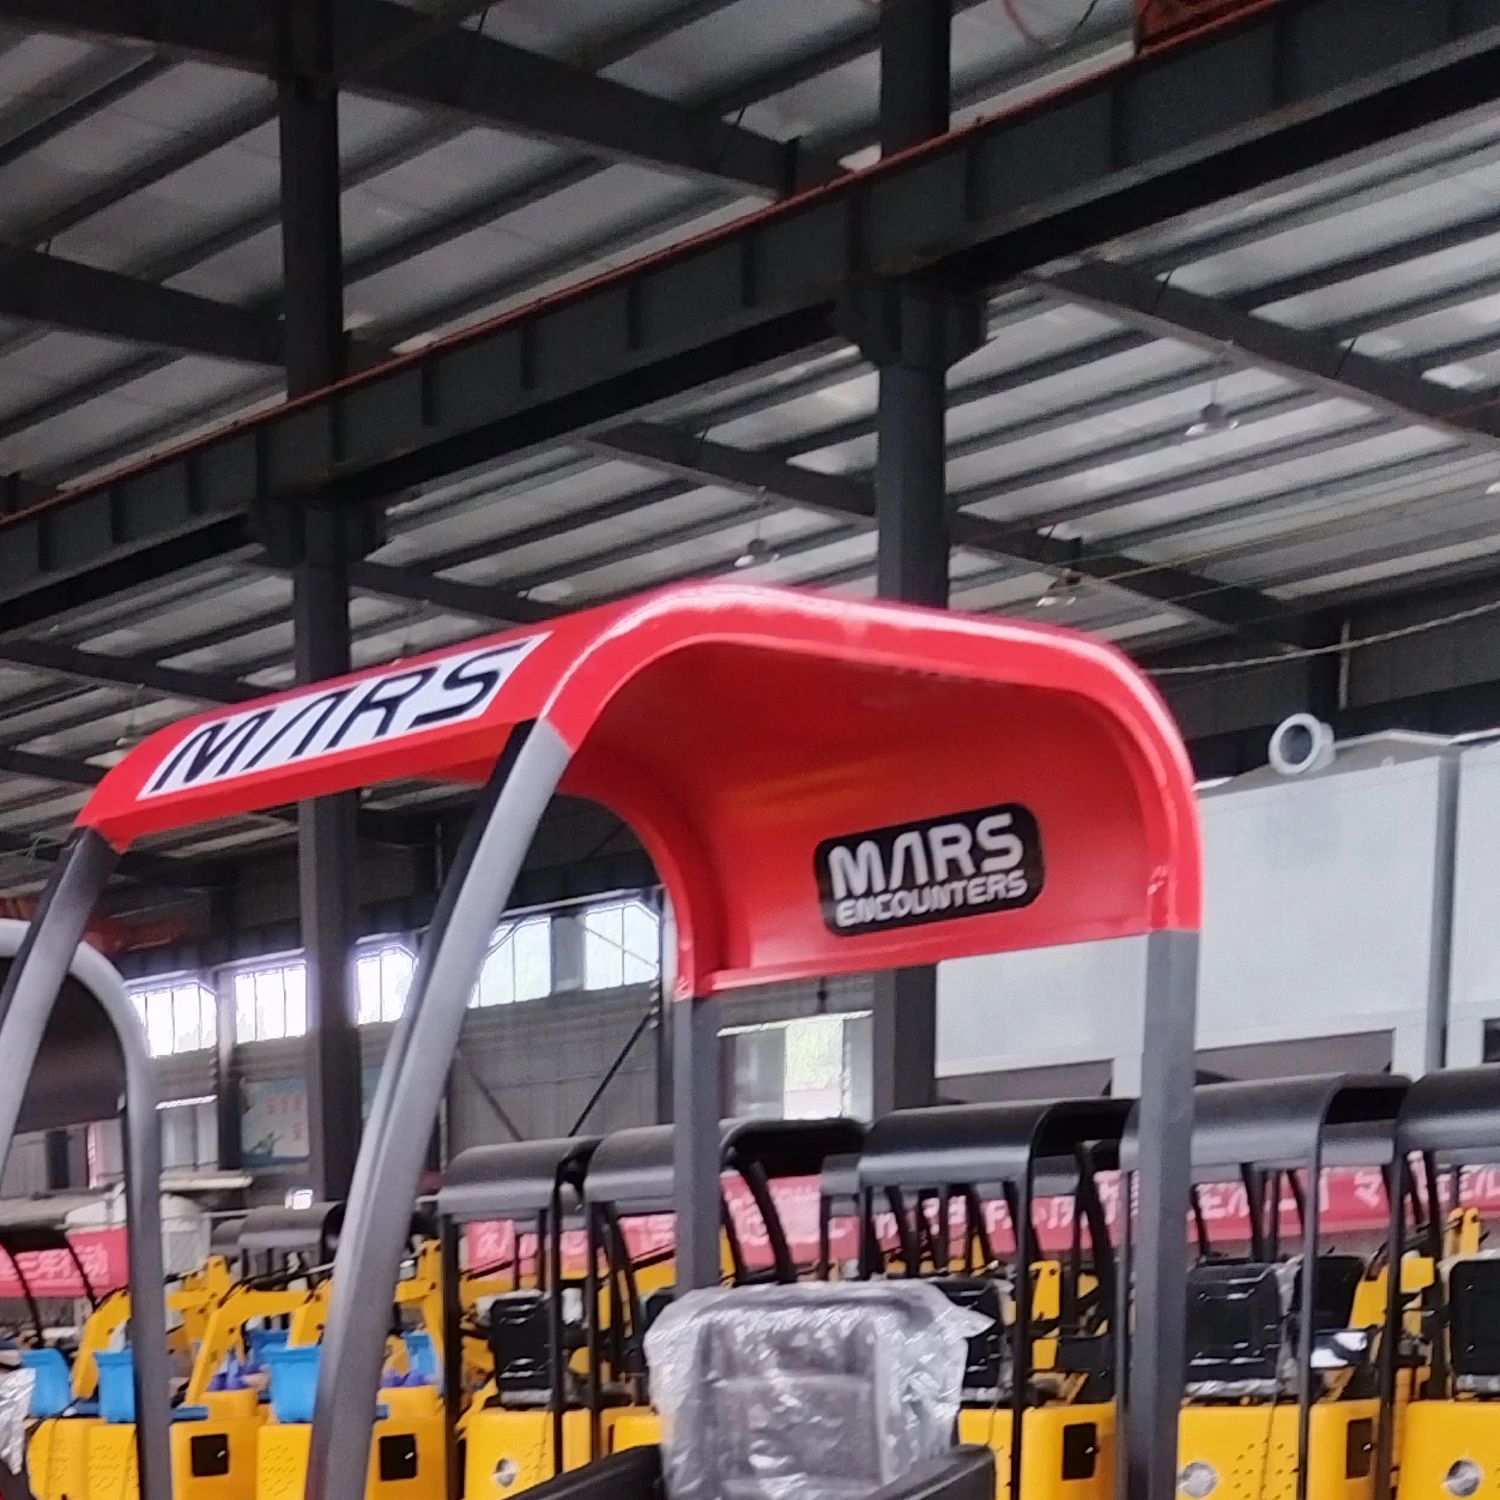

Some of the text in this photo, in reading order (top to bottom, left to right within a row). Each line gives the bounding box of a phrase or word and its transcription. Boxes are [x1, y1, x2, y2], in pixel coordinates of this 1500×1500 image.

[149, 636, 533, 794] MARS
[827, 811, 1025, 901] MARS
[834, 868, 1029, 928] ENCOUNTERS
